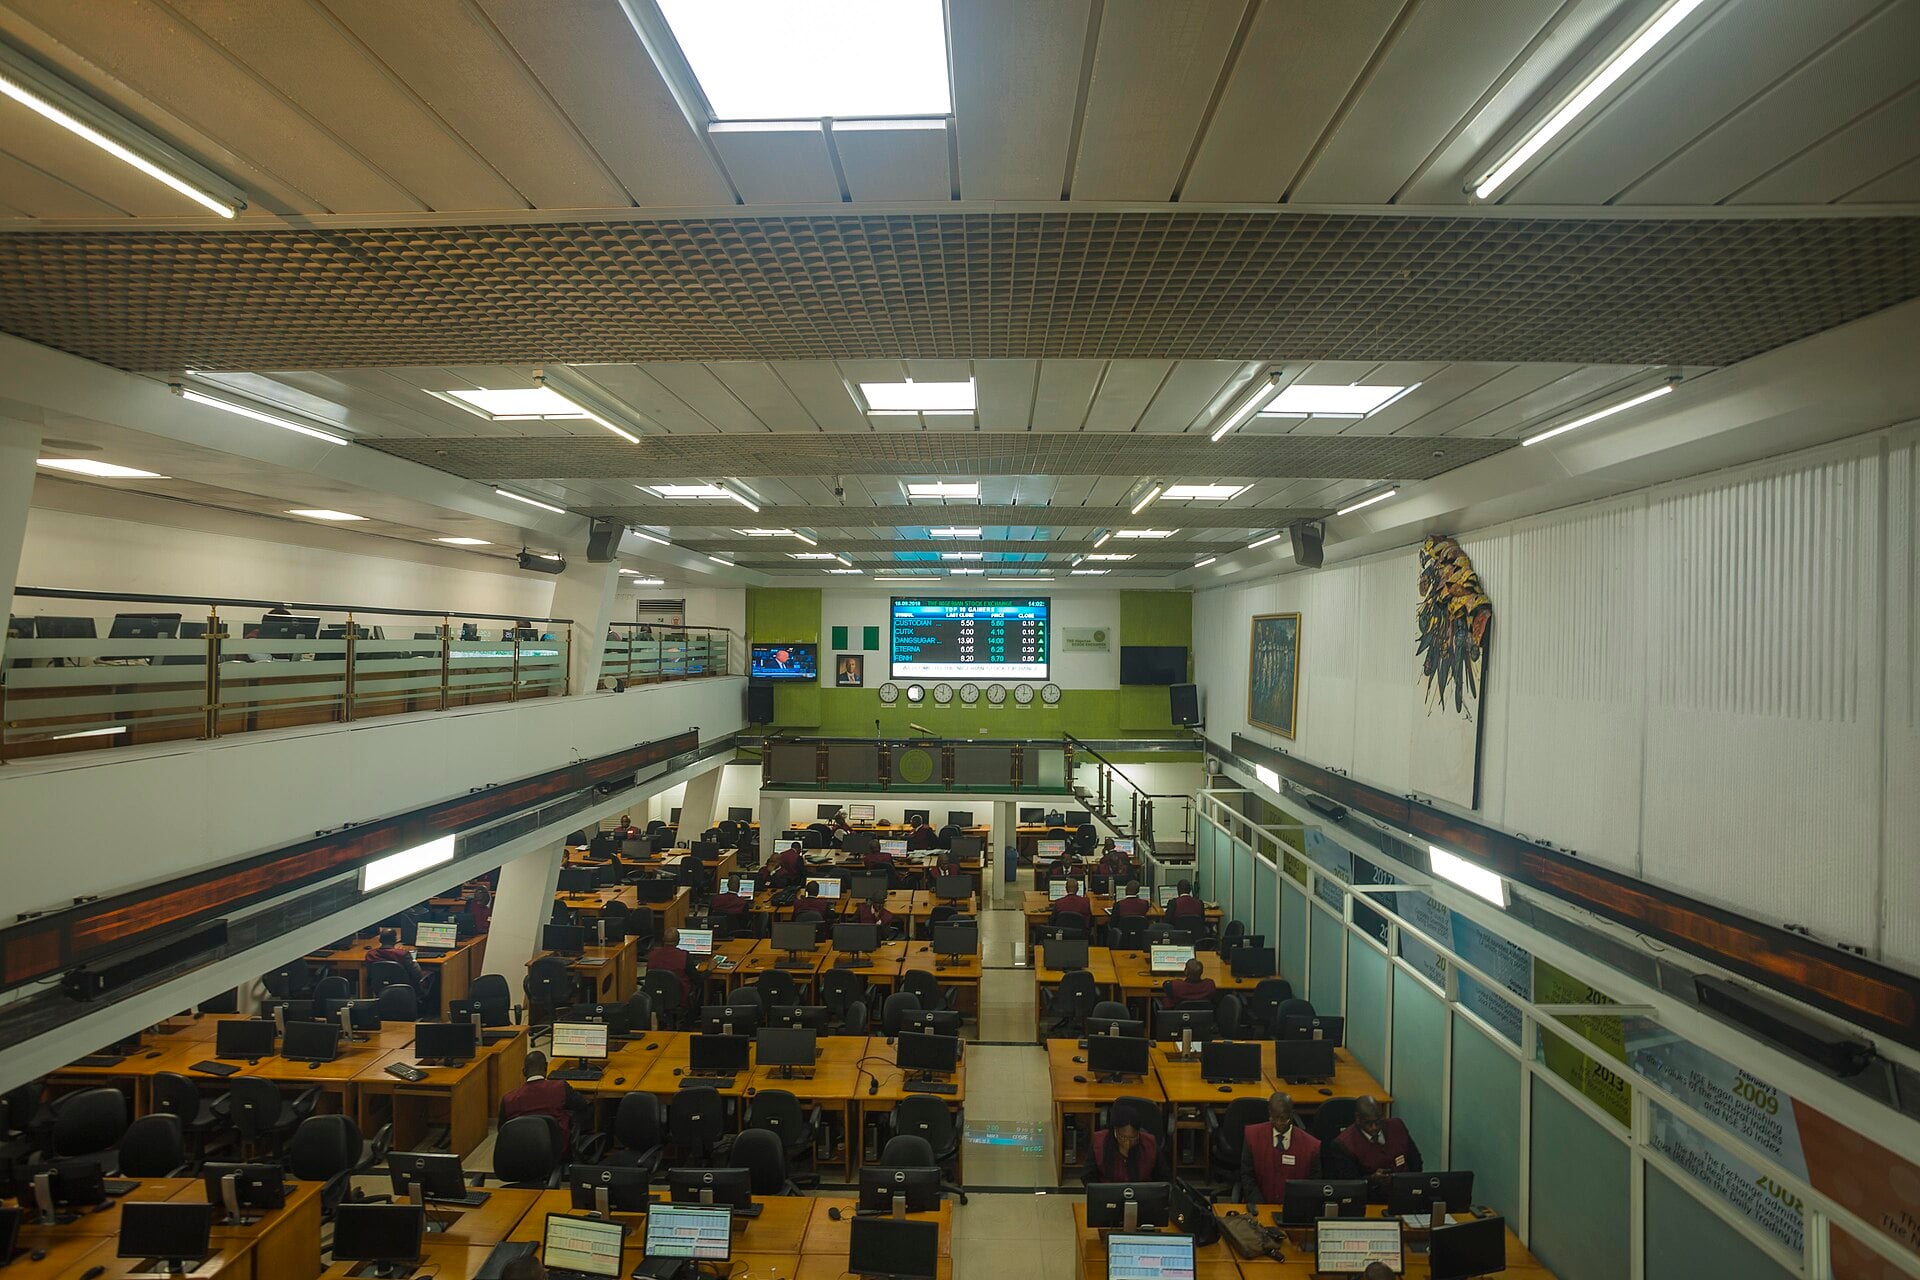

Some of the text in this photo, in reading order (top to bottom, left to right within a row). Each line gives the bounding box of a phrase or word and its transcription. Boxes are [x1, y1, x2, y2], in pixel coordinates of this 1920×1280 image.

[1373, 866, 1394, 885] 2017
[1594, 1062, 1625, 1092] 2013
[1732, 1076, 1779, 1116] 2009
[1739, 1069, 1771, 1093] February
[1690, 1069, 1784, 1134] NSE began publishing
[1699, 1085, 1712, 1100] the
[1749, 1117, 1784, 1146] Indices
[1704, 1101, 1720, 1117] and
[1721, 1109, 1738, 1128] NSE
[1703, 1151, 1719, 1167] The
[1720, 1163, 1764, 1199] Exchange
[1706, 1160, 1725, 1183] Real
[1726, 1177, 1755, 1202] Estate
[1712, 1179, 1729, 1196] the
[1729, 1191, 1753, 1216] Daily
[1753, 1208, 1791, 1246] Trading
